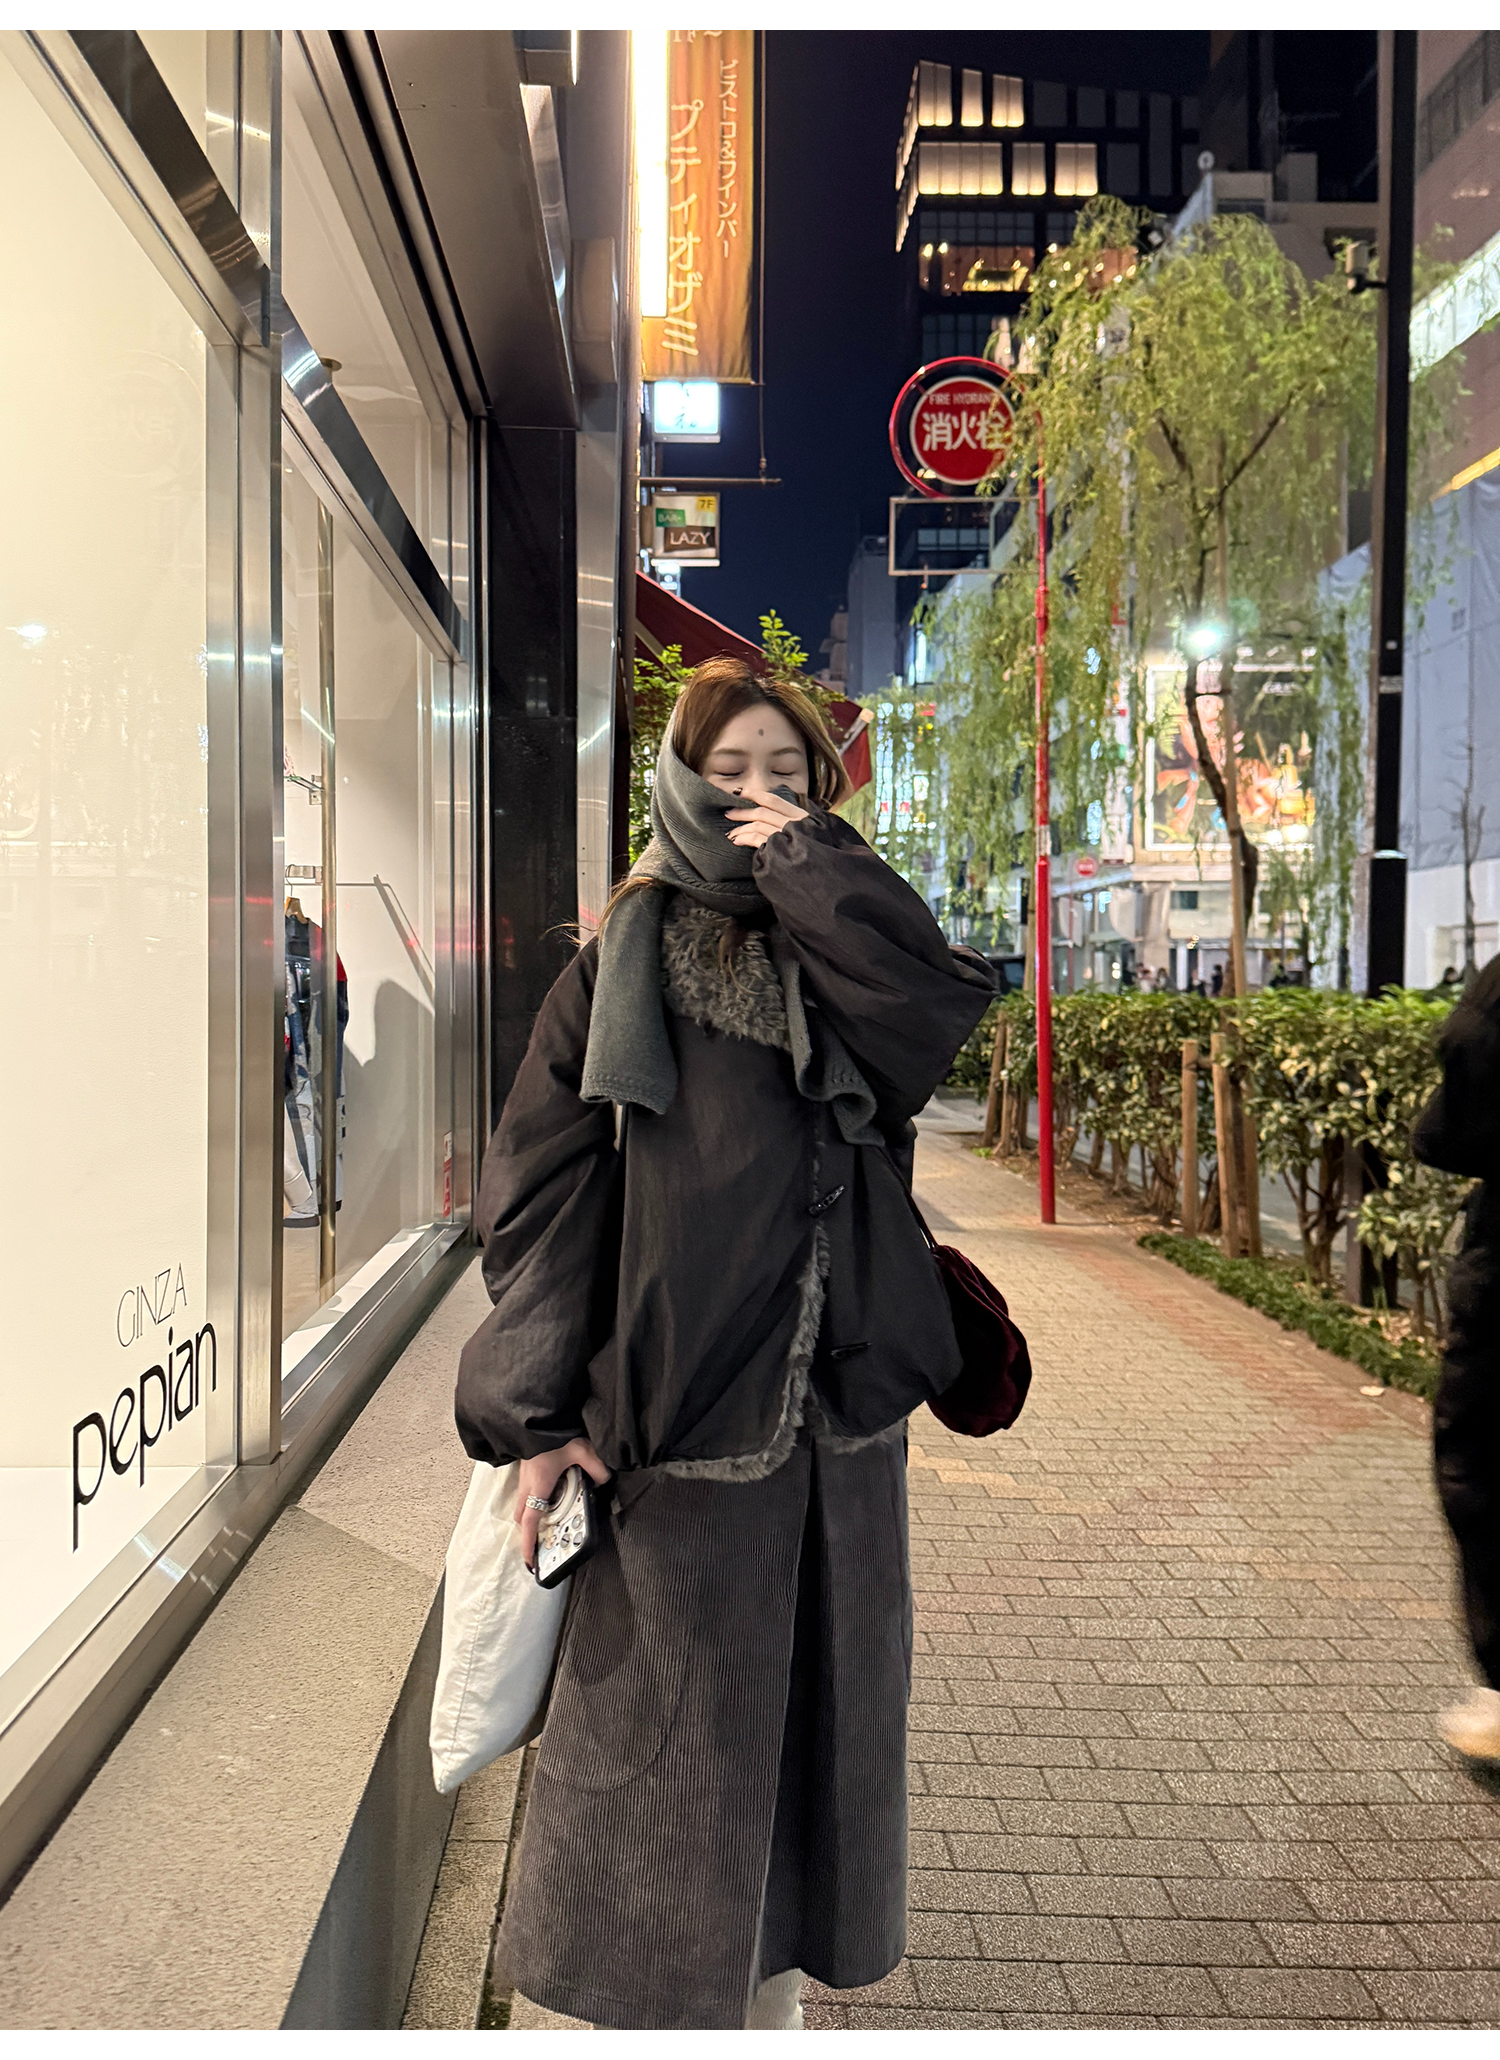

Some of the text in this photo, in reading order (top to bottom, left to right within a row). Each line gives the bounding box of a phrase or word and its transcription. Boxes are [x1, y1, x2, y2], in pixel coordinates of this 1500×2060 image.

[928, 392, 950, 405] FIRE
[921, 410, 1007, 452] 消火栓
[698, 499, 715, 509] 7F
[669, 530, 711, 546] LAZY
[117, 1262, 187, 1348] GINZA
[72, 1322, 217, 1554] pepian
